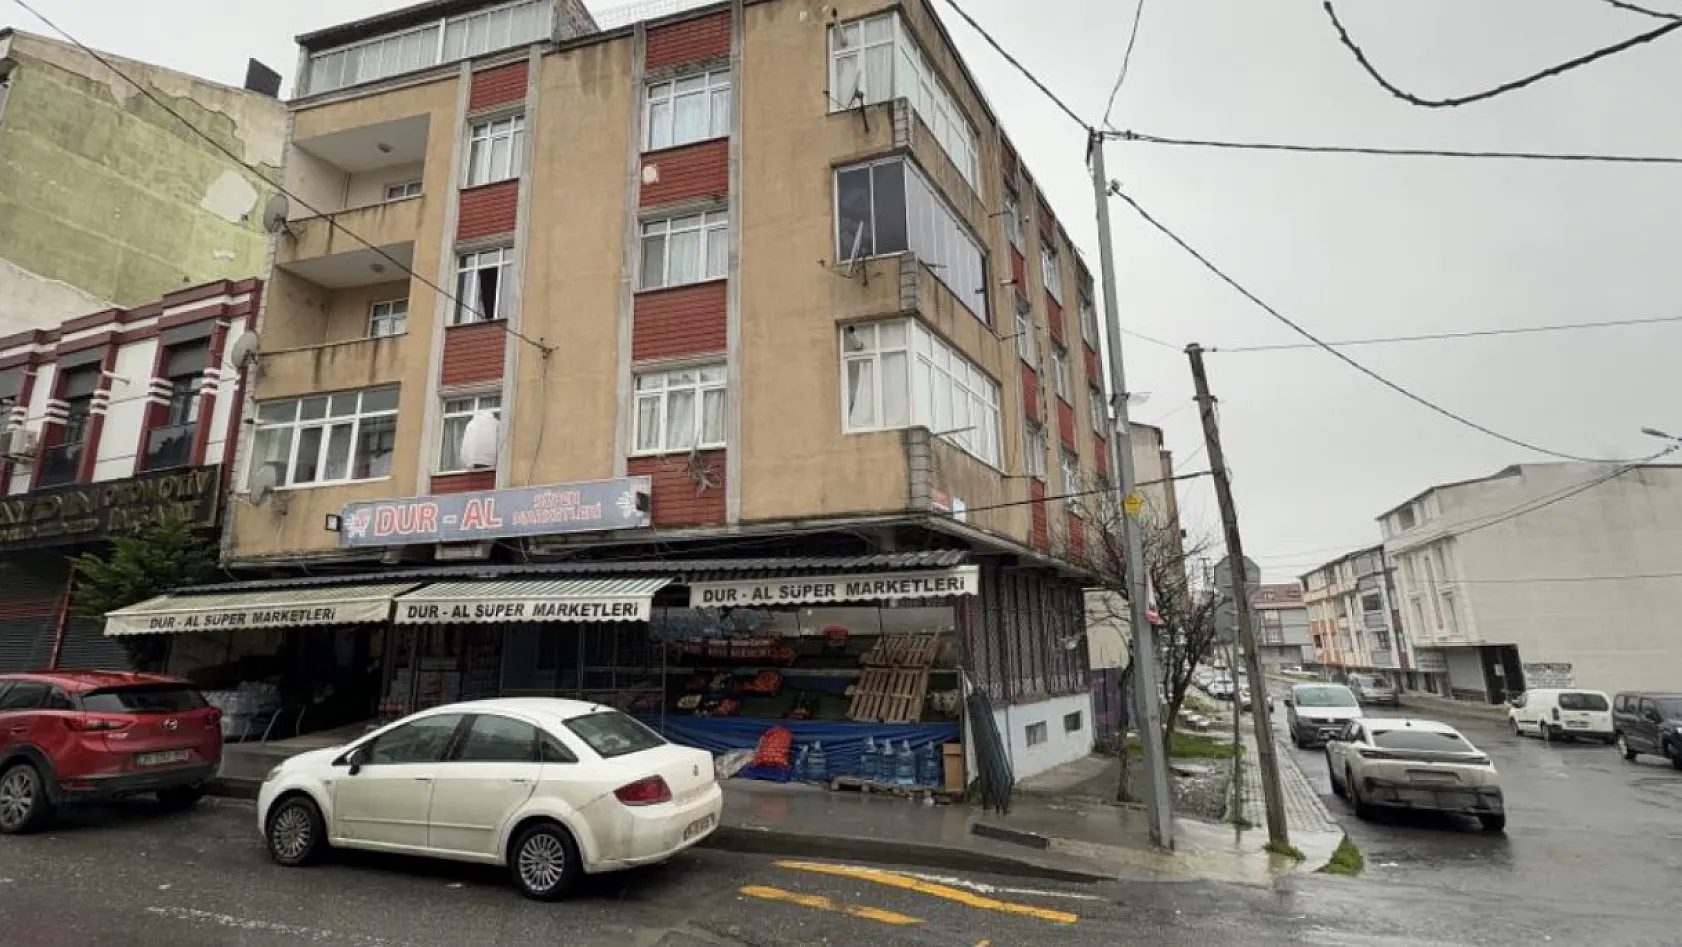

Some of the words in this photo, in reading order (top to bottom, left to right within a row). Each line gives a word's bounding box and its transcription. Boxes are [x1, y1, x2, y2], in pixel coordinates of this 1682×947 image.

[374, 502, 439, 537] DUR
[460, 497, 503, 531] AL
[703, 588, 737, 603] DUR
[752, 586, 773, 601] AL
[779, 583, 836, 599] SÜPER
[846, 576, 965, 596] MARKETLERİ
[407, 605, 439, 619] DUR
[451, 605, 470, 618] AL
[475, 602, 525, 617] SÜPER
[531, 601, 639, 618] MARKETLERİ
[150, 616, 174, 629] DUR
[184, 615, 200, 628] AL
